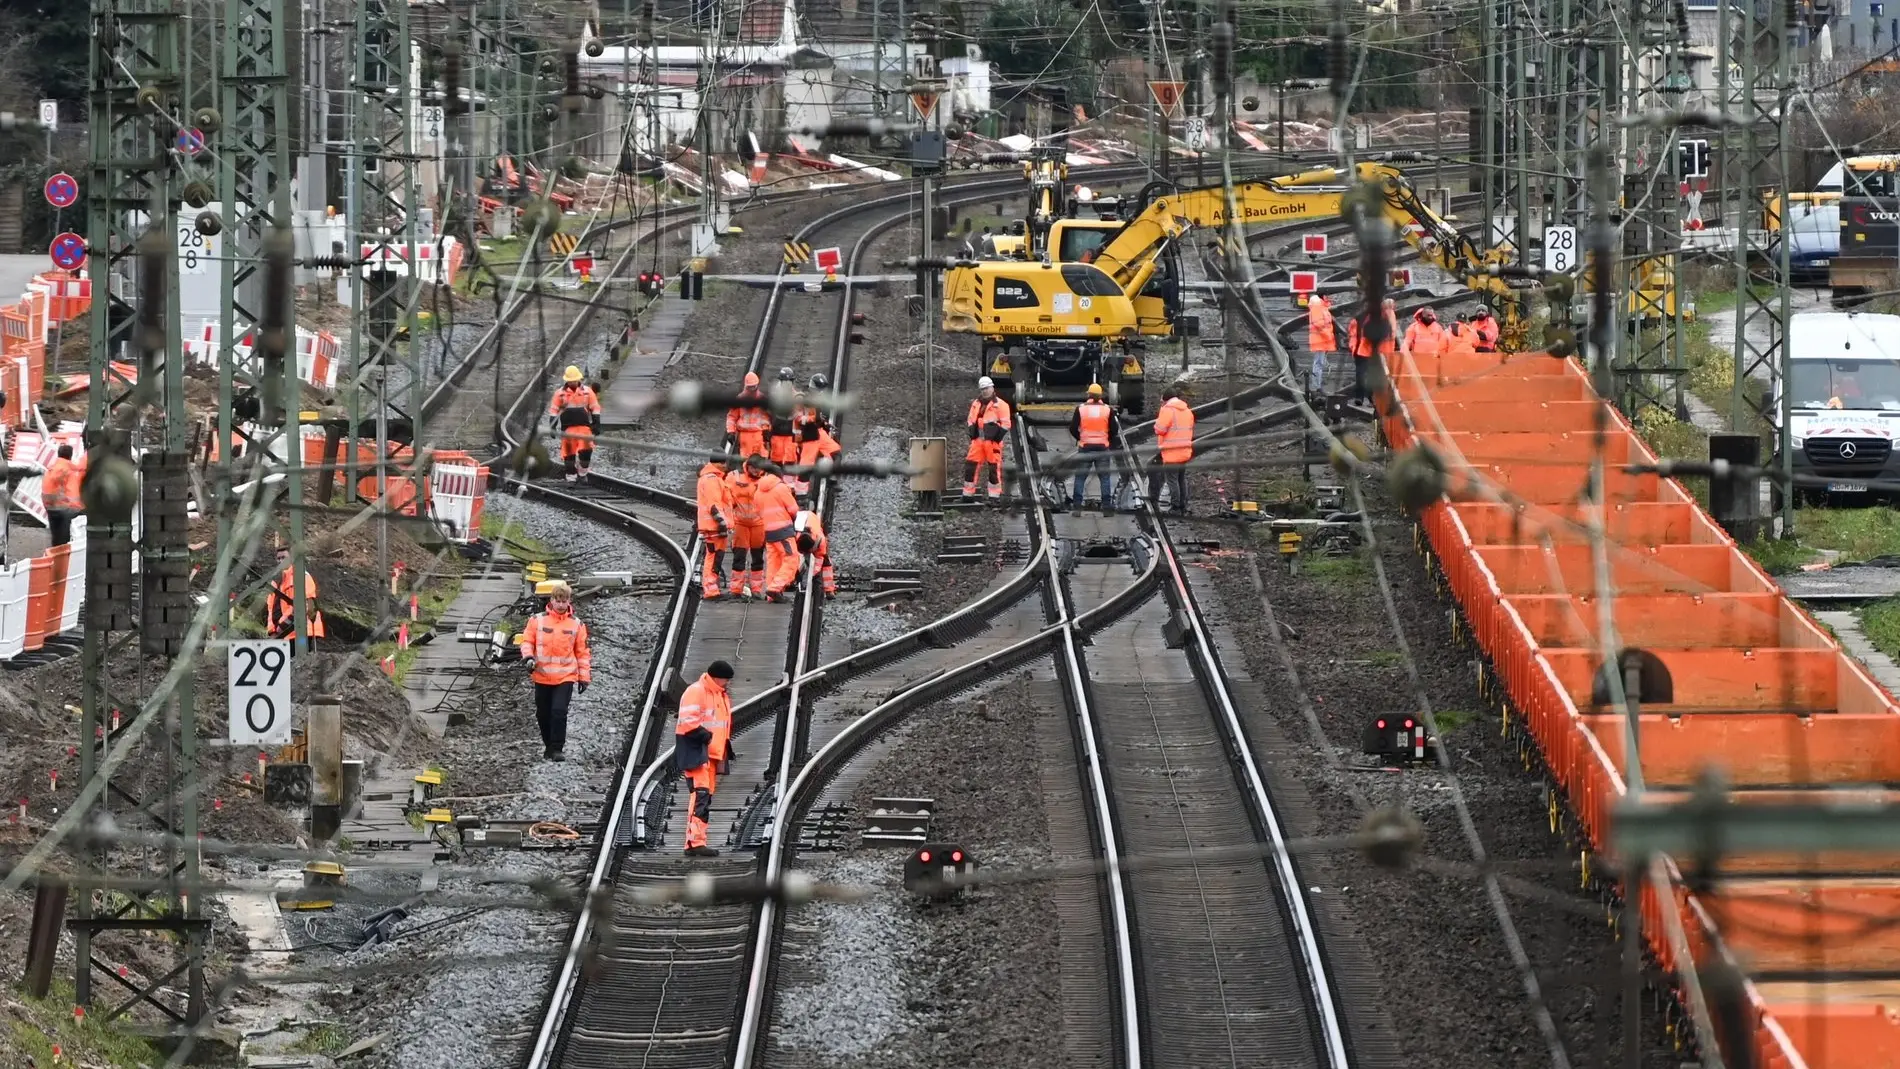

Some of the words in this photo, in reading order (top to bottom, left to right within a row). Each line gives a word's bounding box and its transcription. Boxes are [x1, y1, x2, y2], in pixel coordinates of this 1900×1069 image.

[916, 58, 933, 77] 14
[1163, 87, 1172, 104] 9
[426, 108, 442, 122] 28
[1186, 120, 1204, 132] 28
[1245, 206, 1267, 217] Bau
[1270, 202, 1306, 215] GmbH
[179, 228, 203, 247] 28
[1549, 230, 1572, 249] 28
[186, 250, 197, 269] 8
[1555, 252, 1566, 271] 8
[1081, 299, 1090, 307] 20
[234, 646, 285, 686] 29
[246, 693, 275, 733] 0
